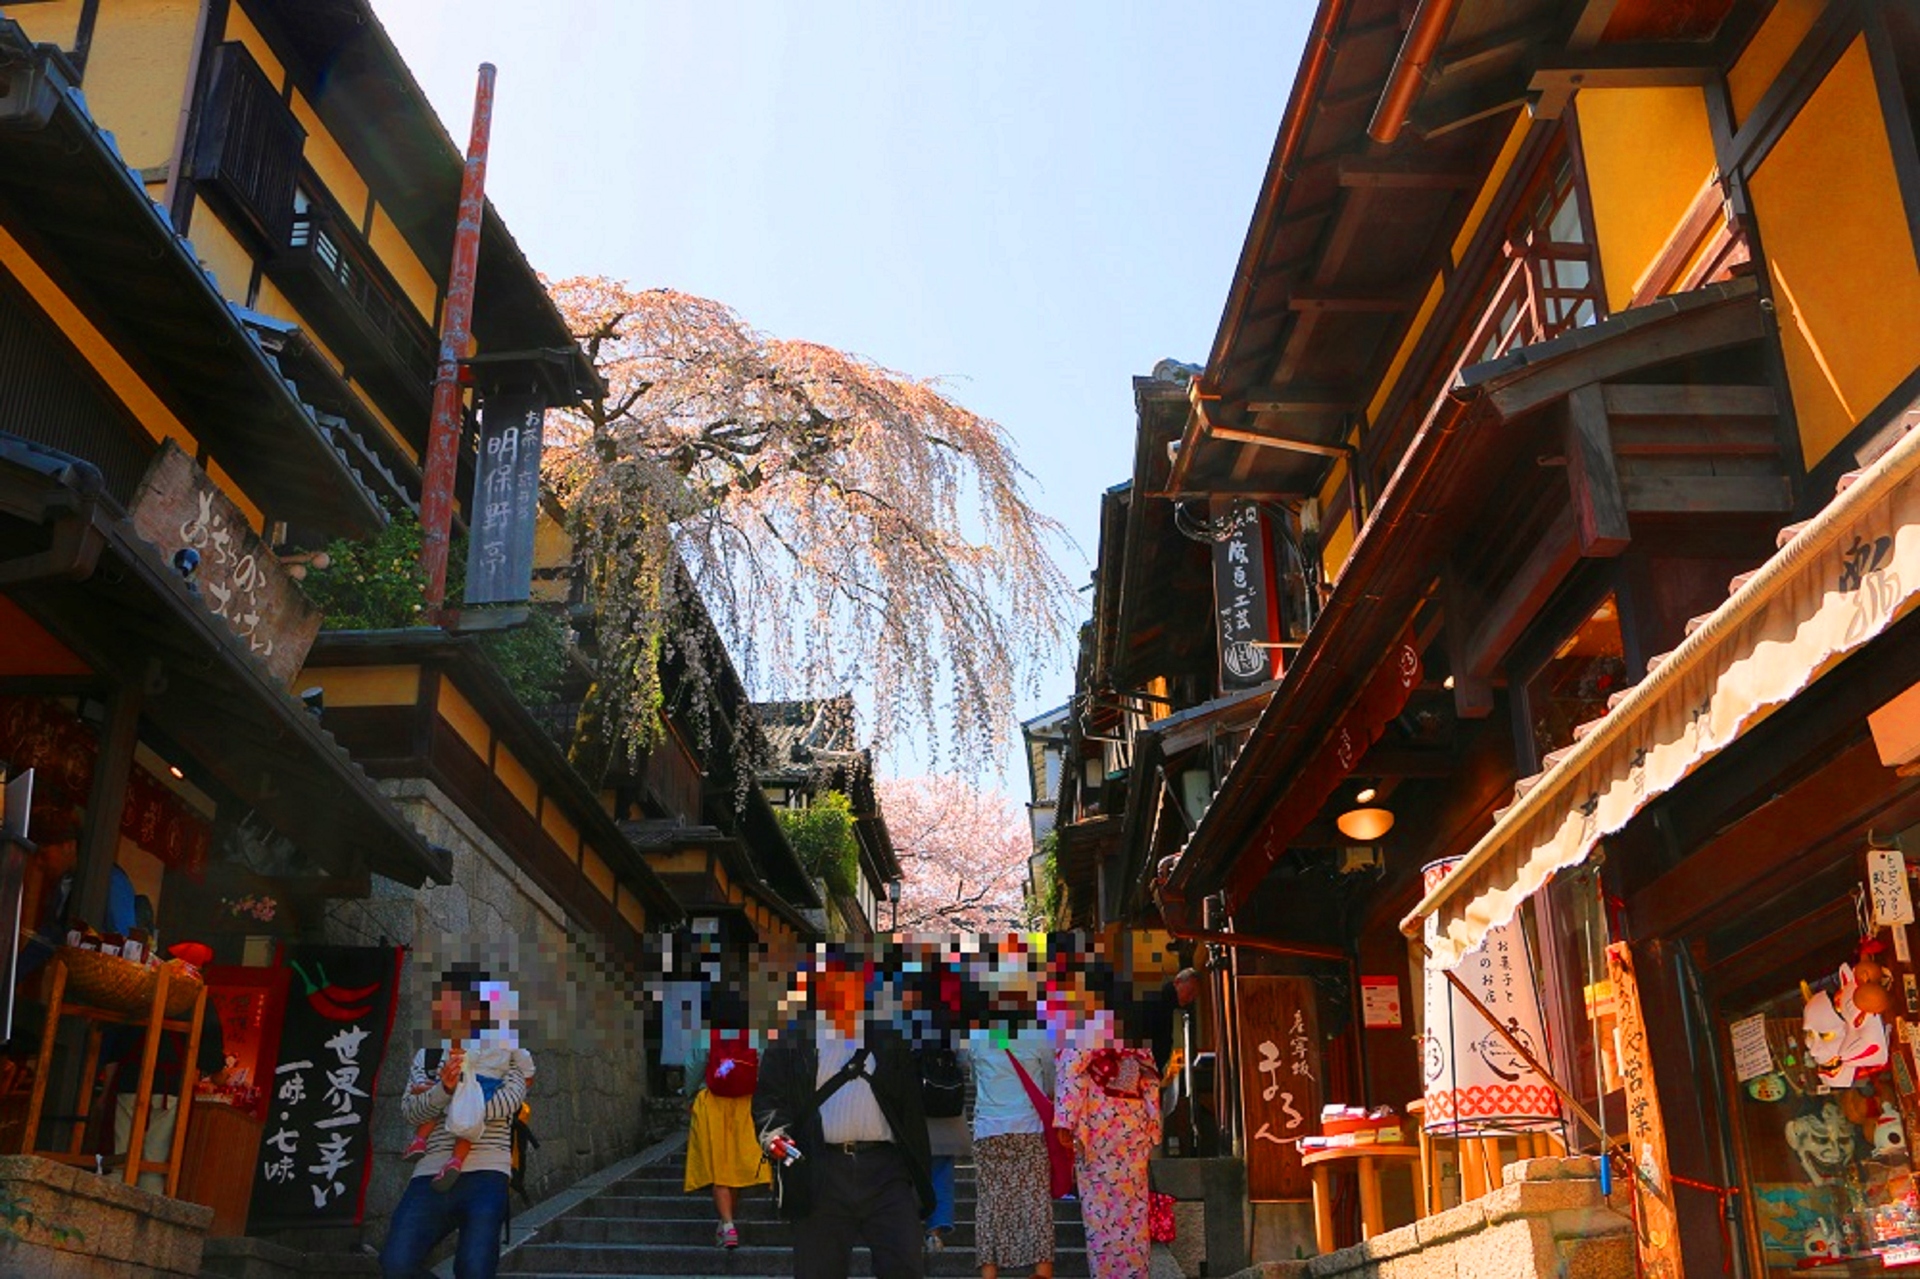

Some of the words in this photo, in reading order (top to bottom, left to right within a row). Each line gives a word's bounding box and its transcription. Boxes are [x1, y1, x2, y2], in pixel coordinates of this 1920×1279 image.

[479, 426, 520, 575] 明保野亭
[1254, 1040, 1304, 1144] まるん
[1288, 1009, 1316, 1082] 産寧坂
[263, 1060, 314, 1185] 一味・七味
[308, 1025, 373, 1209] 世界一辛い
